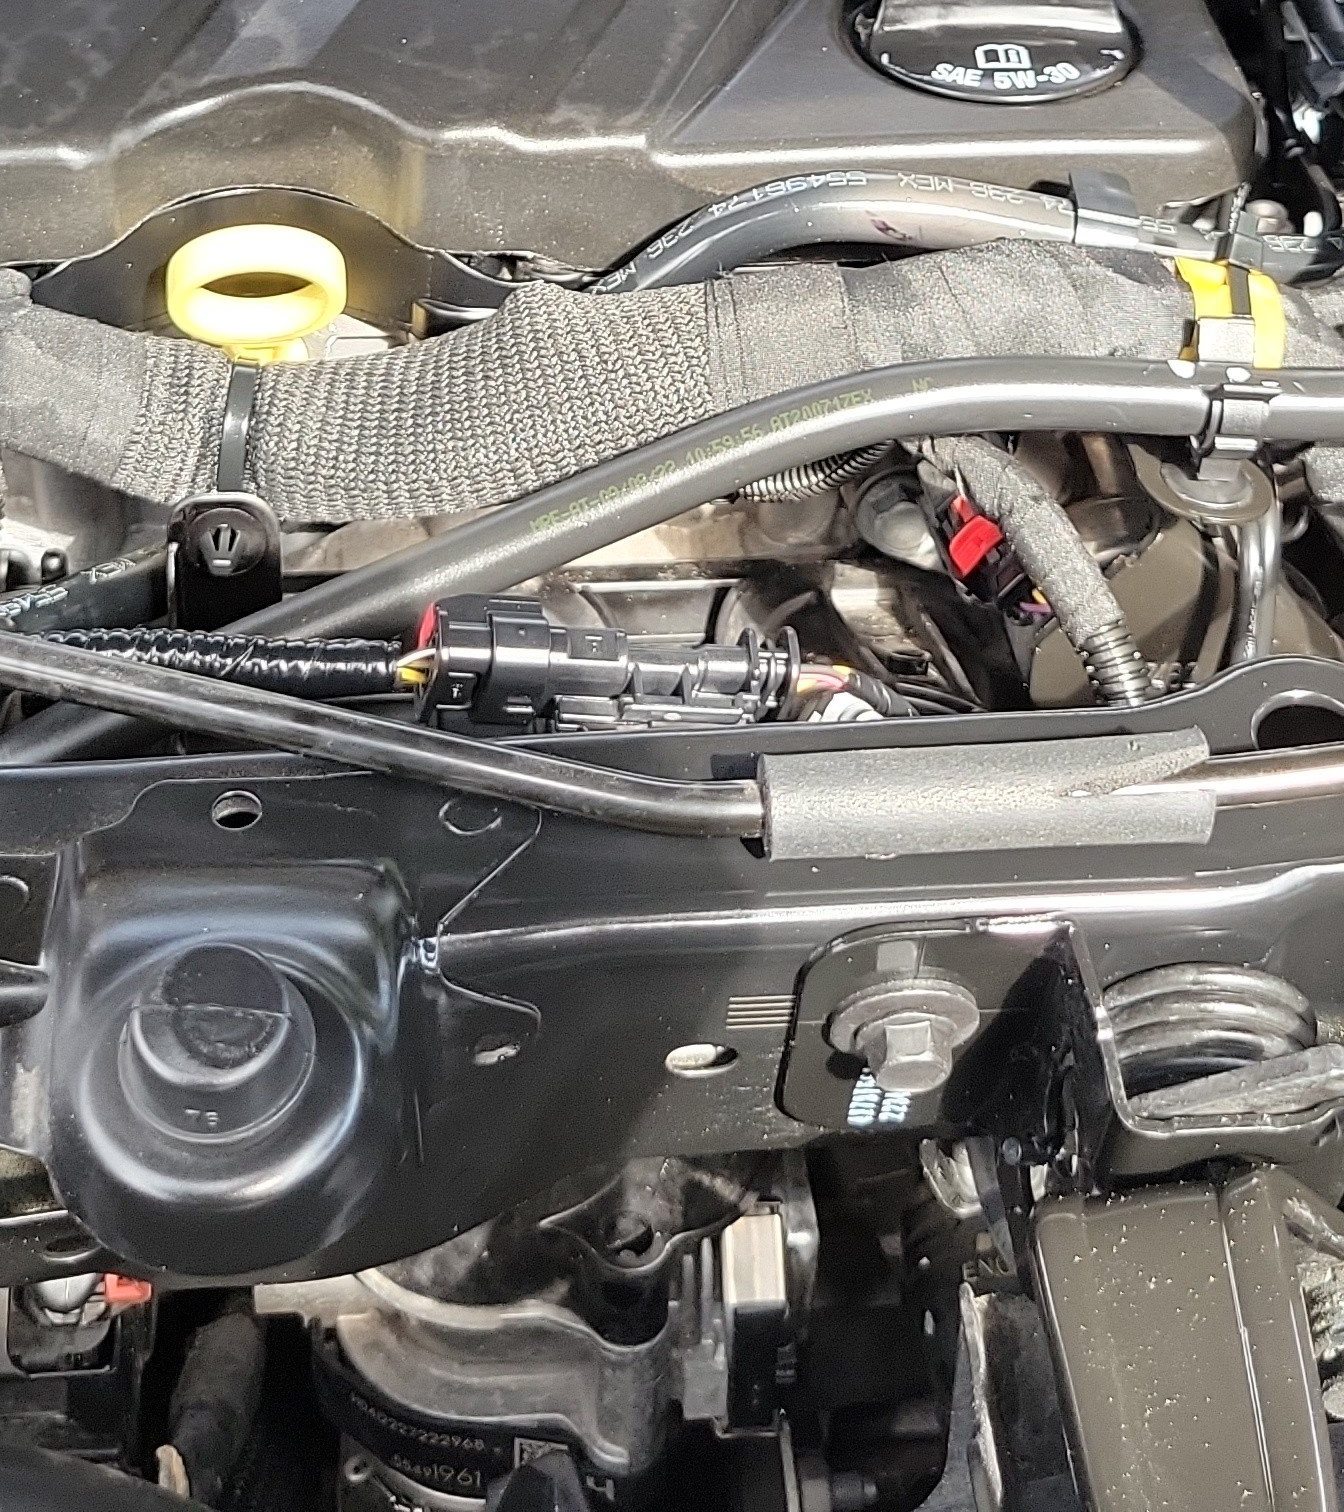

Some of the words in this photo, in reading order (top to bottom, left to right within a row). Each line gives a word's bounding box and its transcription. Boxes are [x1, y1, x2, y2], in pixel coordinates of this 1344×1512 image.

[930, 62, 982, 88] SAE
[993, 62, 1081, 90] 5W-30
[708, 170, 868, 217] 55496174
[898, 172, 954, 193] MEX
[968, 181, 1024, 205] 236
[648, 222, 700, 259] 236
